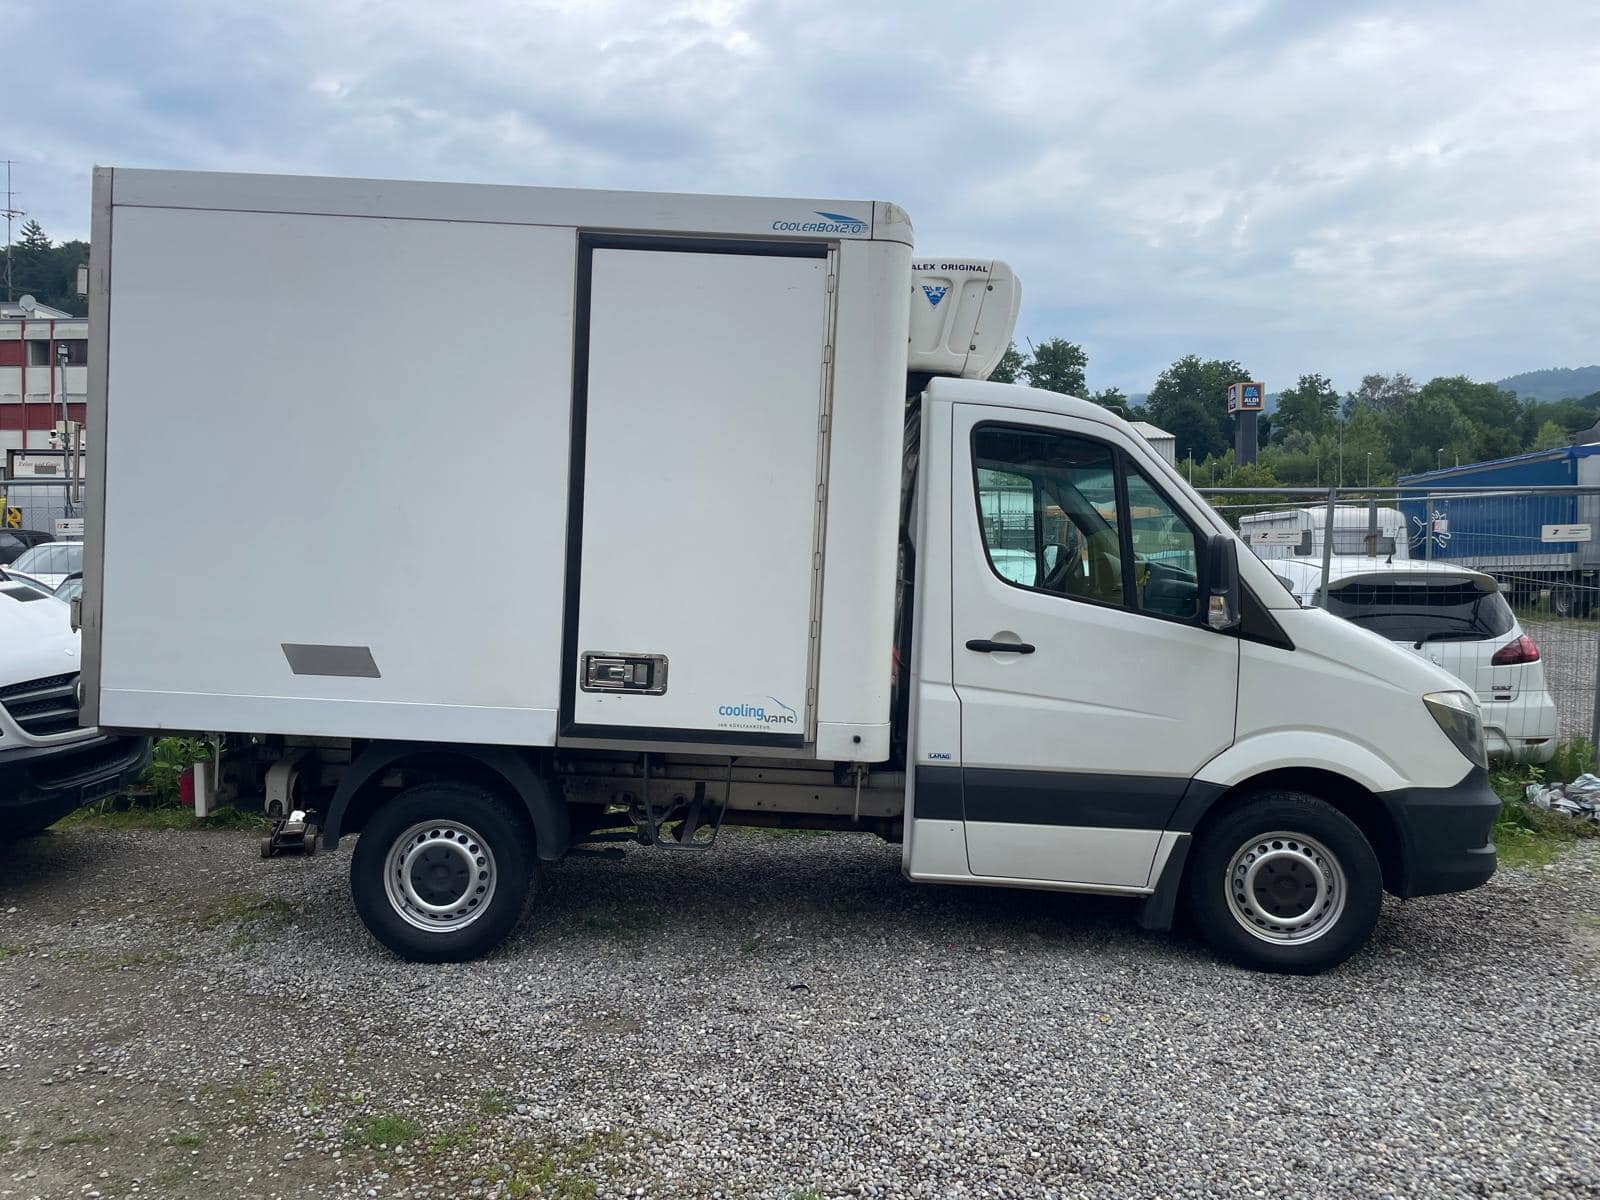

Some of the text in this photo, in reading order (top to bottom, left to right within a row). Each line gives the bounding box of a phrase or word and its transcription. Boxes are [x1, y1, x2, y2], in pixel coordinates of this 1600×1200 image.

[941, 263, 988, 273] ORIGINAL
[718, 703, 765, 721] cooling
[763, 714, 794, 724] vans
